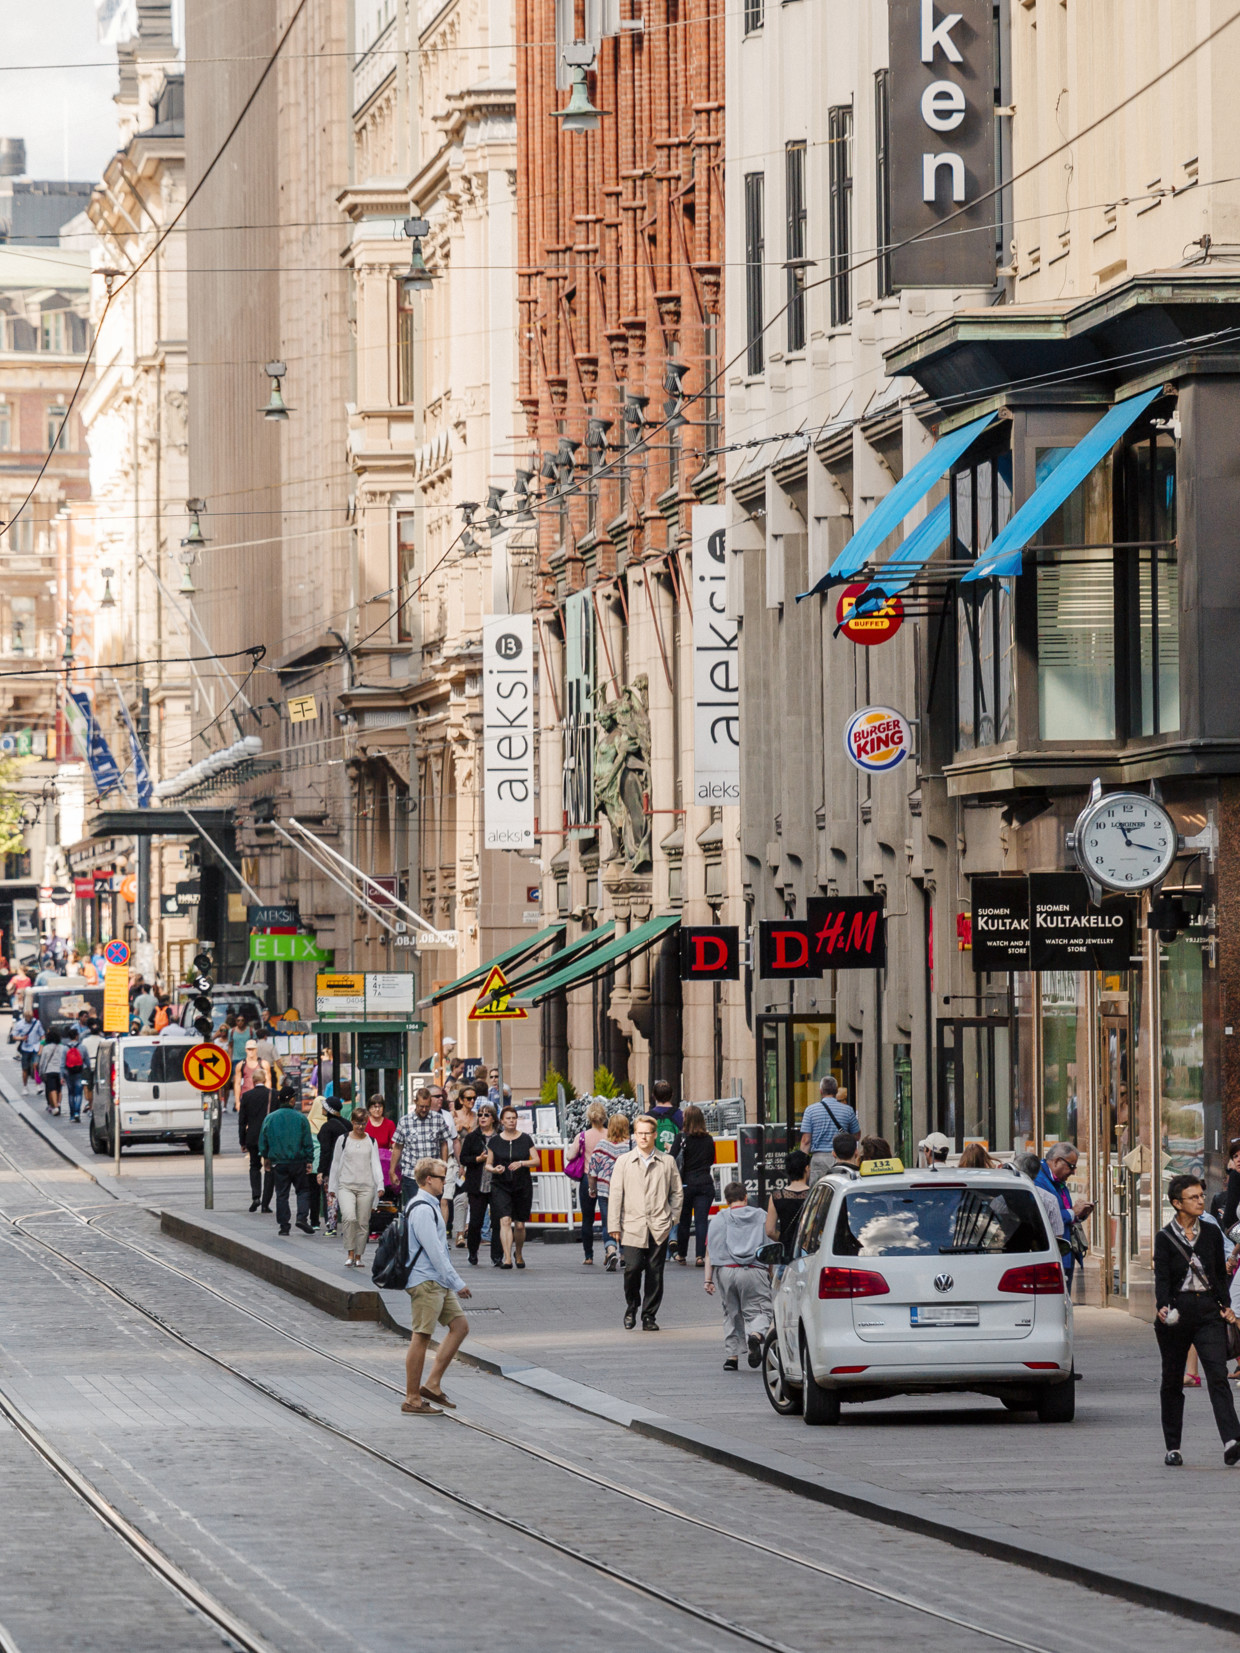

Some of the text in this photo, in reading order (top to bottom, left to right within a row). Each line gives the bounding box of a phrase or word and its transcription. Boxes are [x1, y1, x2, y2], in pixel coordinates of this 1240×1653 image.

[842, 597, 897, 617] RX
[853, 719, 901, 744] BURGER
[856, 729, 904, 760] KING
[1107, 809, 1115, 817] 11
[1122, 804, 1134, 813] 12
[1144, 809, 1148, 817] 1
[1095, 821, 1106, 830] 10
[1153, 821, 1162, 829] 2
[1090, 839, 1099, 848] 9
[1158, 838, 1167, 847] 3
[1095, 855, 1104, 865] 8
[1153, 855, 1162, 863] 4
[1108, 868, 1116, 877] 7
[1125, 872, 1133, 881] 6
[1142, 868, 1150, 876] 5
[1036, 904, 1070, 912] SUOMEN
[1036, 913, 1124, 928] KULTAKELLO
[815, 911, 879, 955] H&M
[873, 1160, 891, 1168] 132
